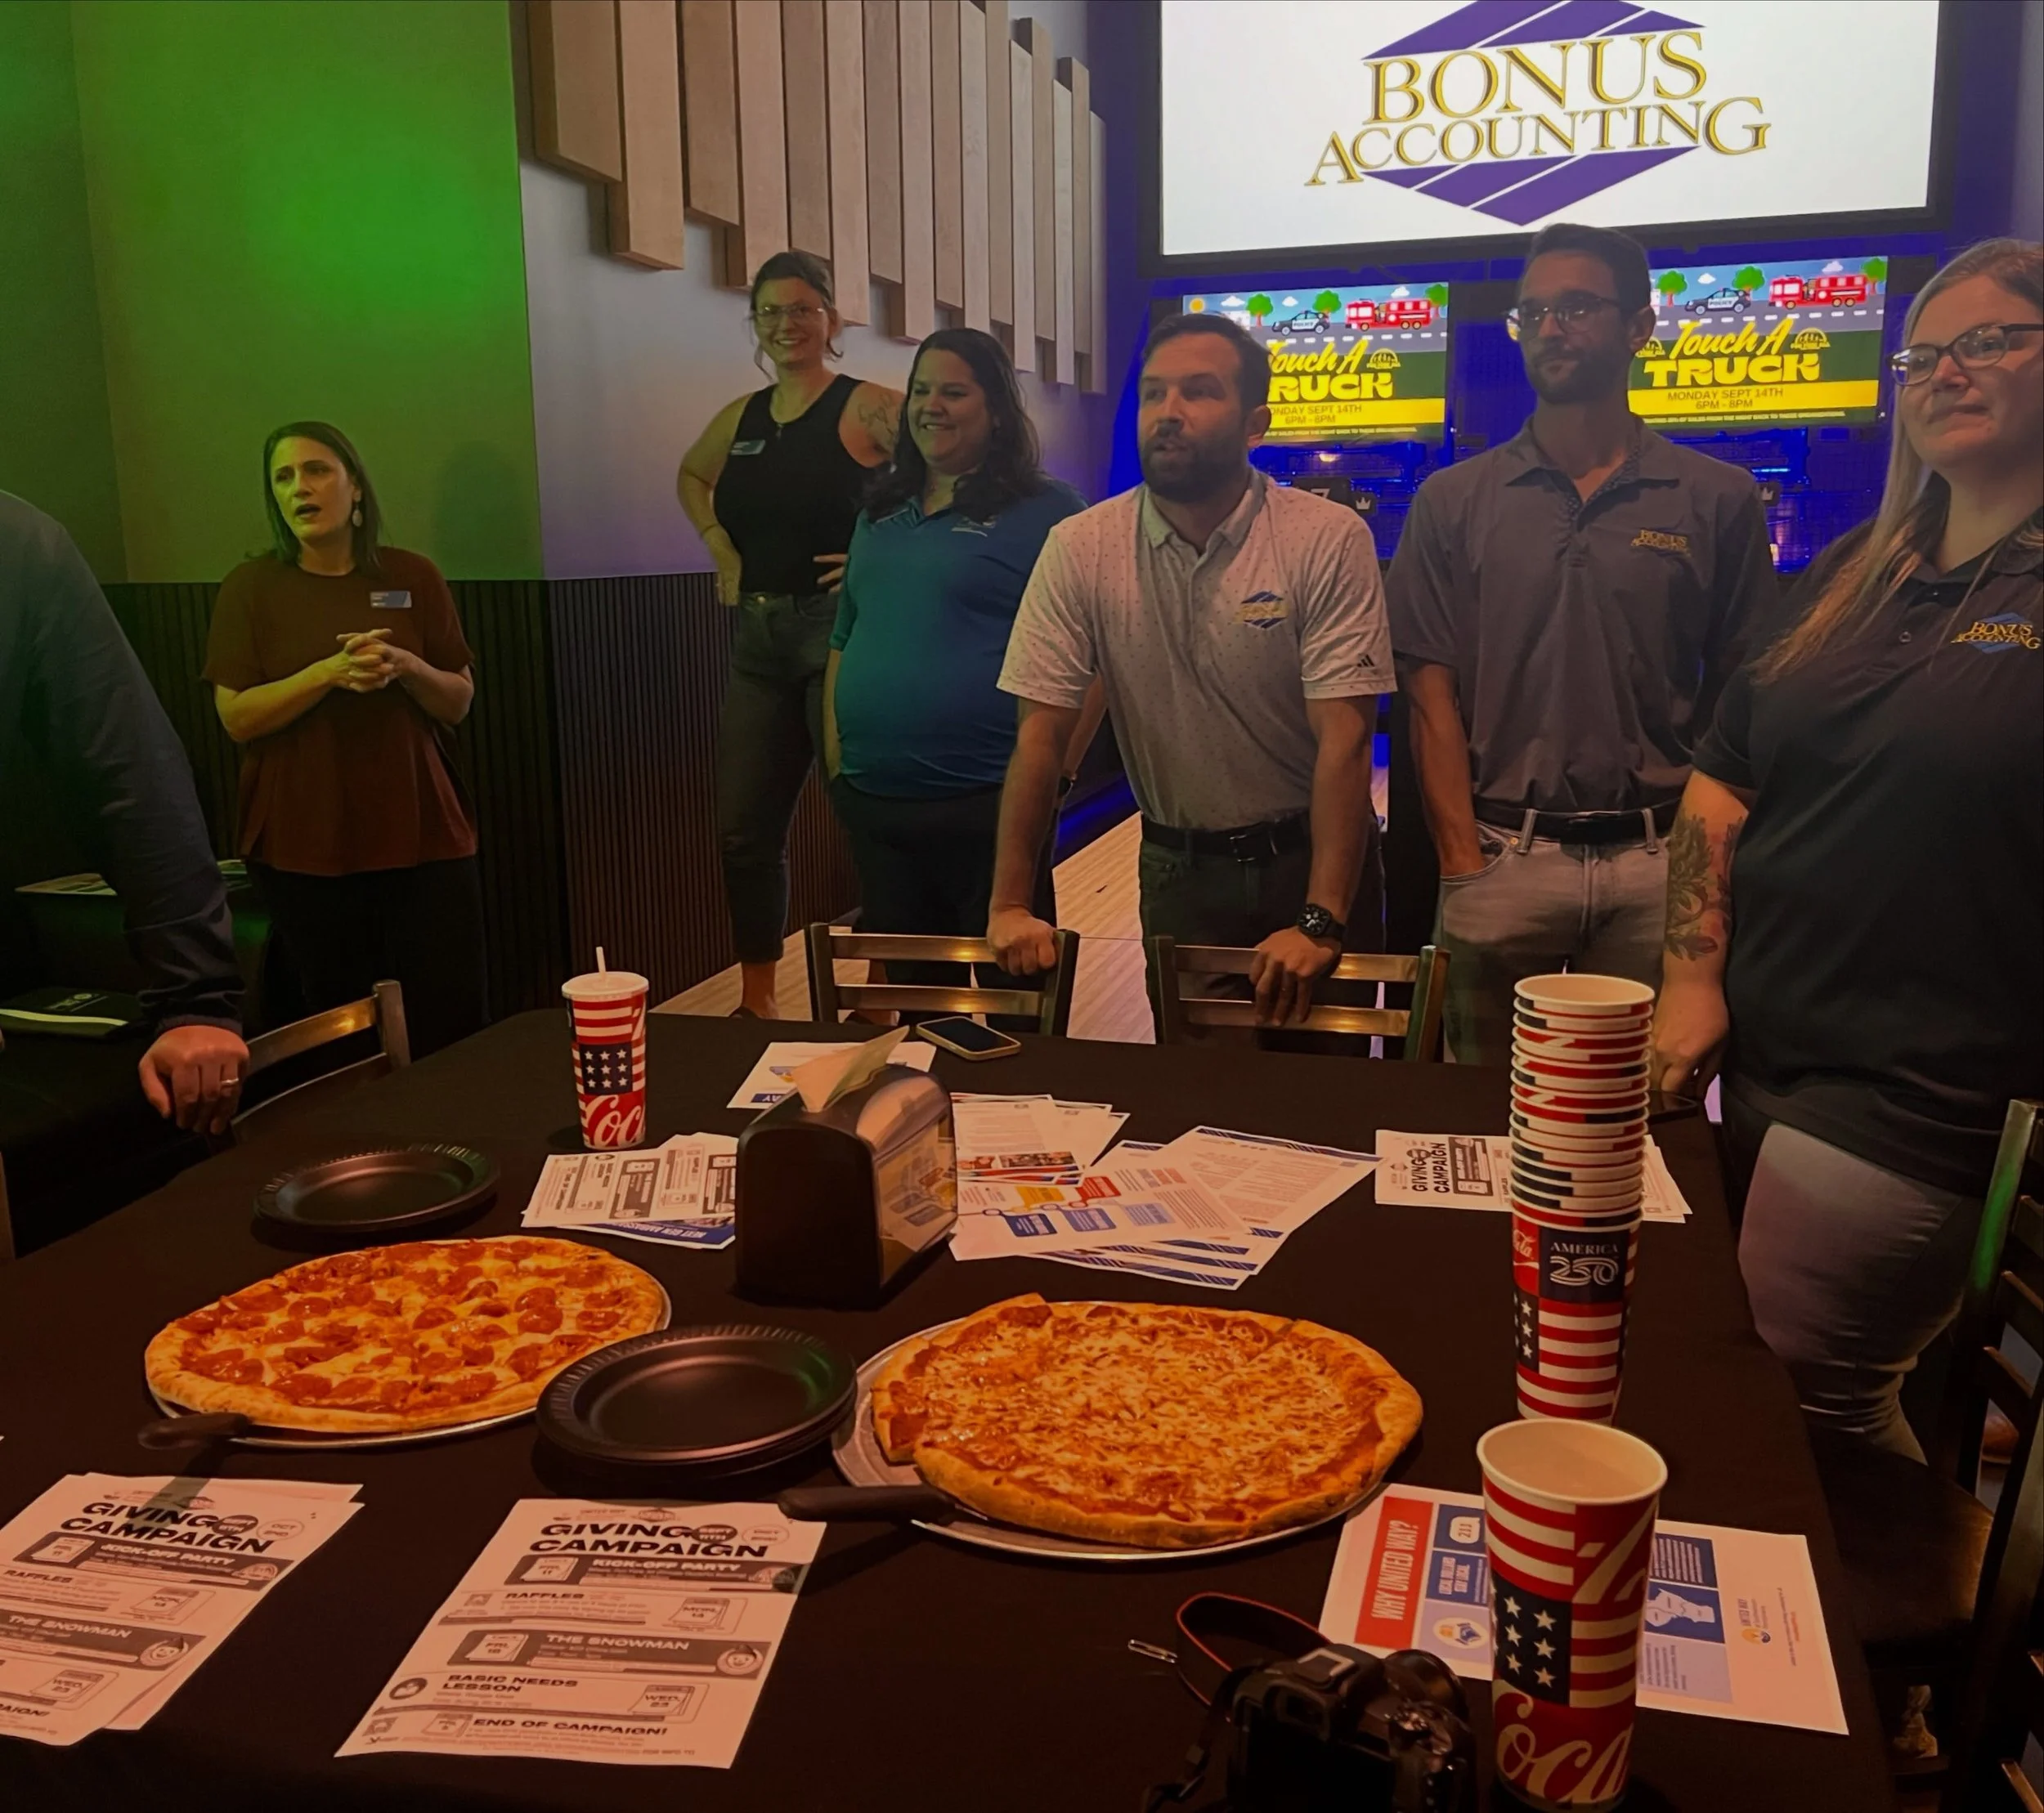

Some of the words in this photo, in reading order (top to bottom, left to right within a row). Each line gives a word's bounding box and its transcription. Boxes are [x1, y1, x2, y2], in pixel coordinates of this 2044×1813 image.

[1362, 31, 1707, 126] BONUS
[1304, 96, 1772, 186] ACCOUNTING
[1670, 320, 1757, 360] Touch
[1755, 317, 1795, 356] A
[1336, 338, 1369, 374] A
[1644, 353, 1820, 387] TRUCK
[1267, 372, 1393, 402] RUCK
[1668, 392, 1719, 401] MONDAY
[1722, 389, 1751, 399] SEPT
[1755, 387, 1784, 398] 14TH
[1271, 405, 1305, 415] ONDAY
[1308, 404, 1334, 414] SEPT
[1338, 403, 1362, 414] 14TH
[1696, 400, 1719, 410] 6PM
[1728, 399, 1753, 409] 8PM
[1284, 415, 1307, 425] 6PM
[1970, 621, 2033, 636] BONUS
[1411, 1159, 1428, 1192] GIVING
[1429, 1143, 1450, 1193] CAMPAIGN
[1550, 1242, 1619, 1256] AMERICA
[1549, 1255, 1620, 1287] 250
[83, 1502, 219, 1528] GIVING
[61, 1518, 275, 1553] CAMPAIGN
[541, 1523, 692, 1538] GIVING
[1384, 1519, 1419, 1551] WAY?
[530, 1540, 769, 1558] CAMPAIGN
[3, 1569, 74, 1583] RAFFLES
[592, 1559, 680, 1569] KICK-OFF
[682, 1561, 742, 1572] PARTY
[1376, 1550, 1414, 1592] UNITED
[1370, 1589, 1407, 1621] WHY
[8, 1614, 38, 1627] THE
[42, 1620, 133, 1639] SNOWMAN
[546, 1634, 585, 1645] THE
[587, 1636, 690, 1651] SNOWMAN
[442, 1683, 522, 1694] LESSON
[447, 1674, 509, 1684] BASIC
[512, 1676, 579, 1688] NEEDS
[473, 1717, 515, 1727] END
[520, 1719, 549, 1730] OF
[553, 1721, 668, 1736] CAMPAIGN!
